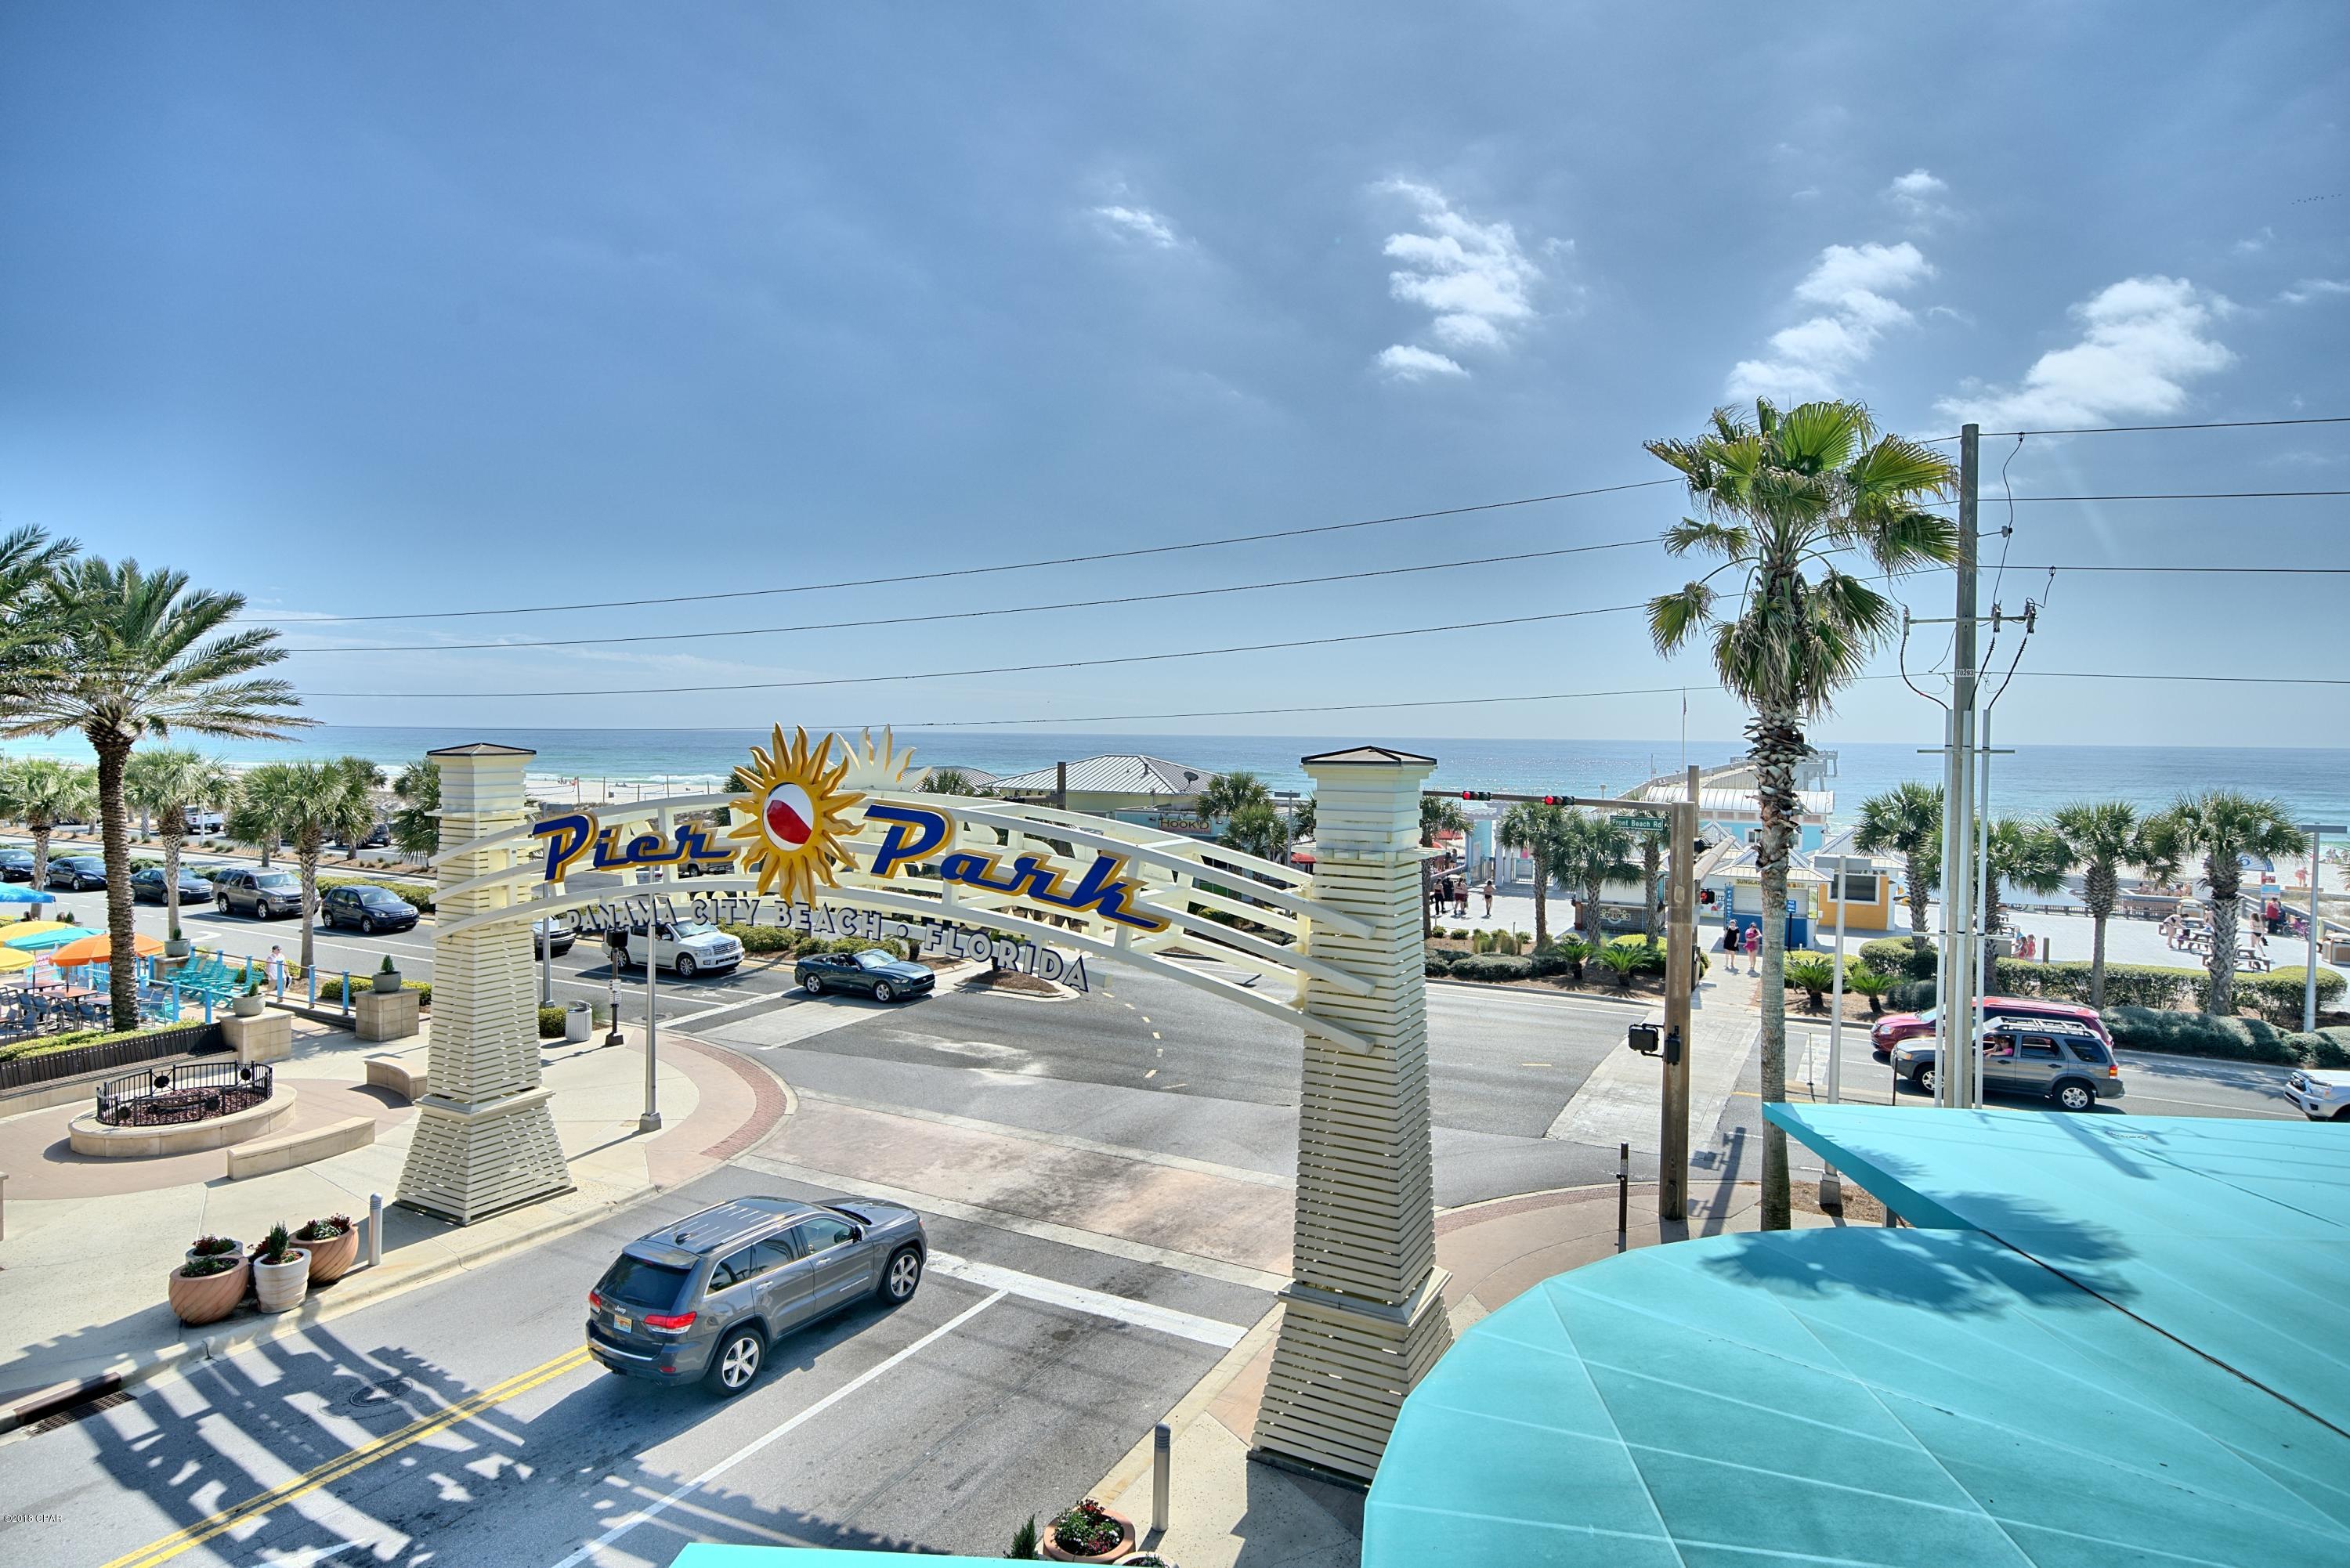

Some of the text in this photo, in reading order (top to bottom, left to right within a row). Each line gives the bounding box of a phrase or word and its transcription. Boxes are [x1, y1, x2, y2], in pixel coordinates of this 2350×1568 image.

[1160, 819, 1210, 829] HOOK'D
[1631, 819, 1650, 828] Beach
[532, 811, 741, 884] Pier
[862, 800, 1172, 933] Park
[566, 898, 1090, 992] PANAMA CITY BEACH FLORIDA
[615, 1305, 627, 1314] Jeep
